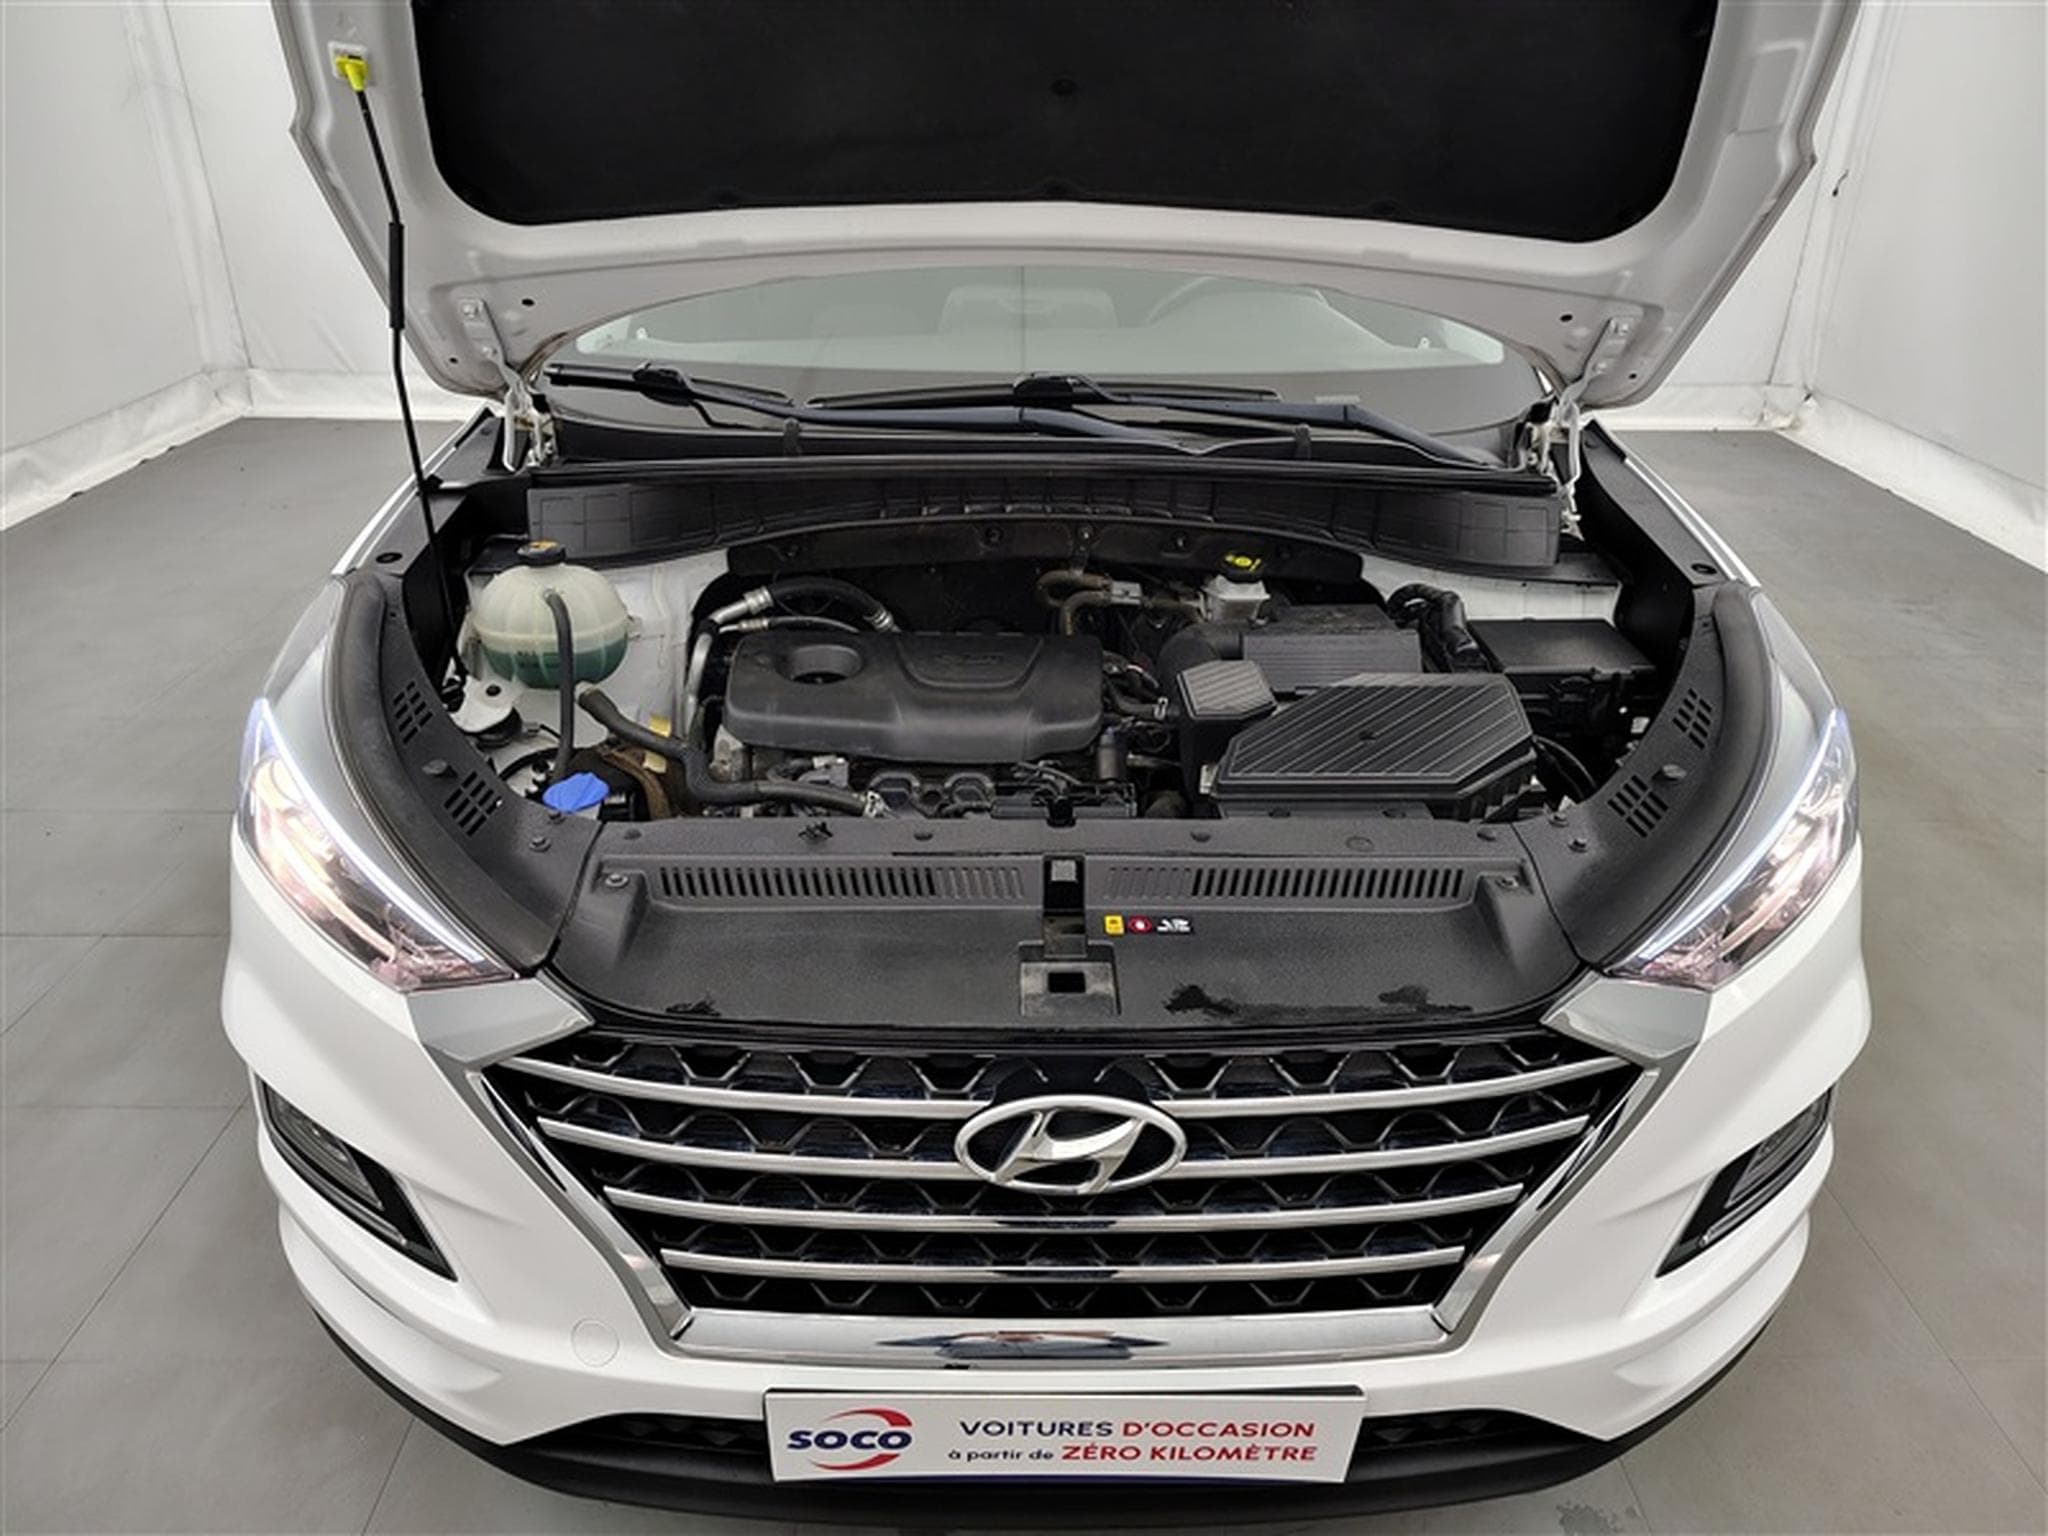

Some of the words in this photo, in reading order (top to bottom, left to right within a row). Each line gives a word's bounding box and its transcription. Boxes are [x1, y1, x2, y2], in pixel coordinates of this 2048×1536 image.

[959, 1421, 1113, 1437] VOITURES
[1122, 1421, 1316, 1438] D'OCCASION
[787, 1430, 912, 1450] SOCO
[948, 1447, 962, 1460] à
[966, 1448, 1022, 1462] partir
[1029, 1447, 1053, 1460] de
[1062, 1442, 1141, 1460] ZÉRO
[1150, 1442, 1318, 1461] KILOMÈTRE
